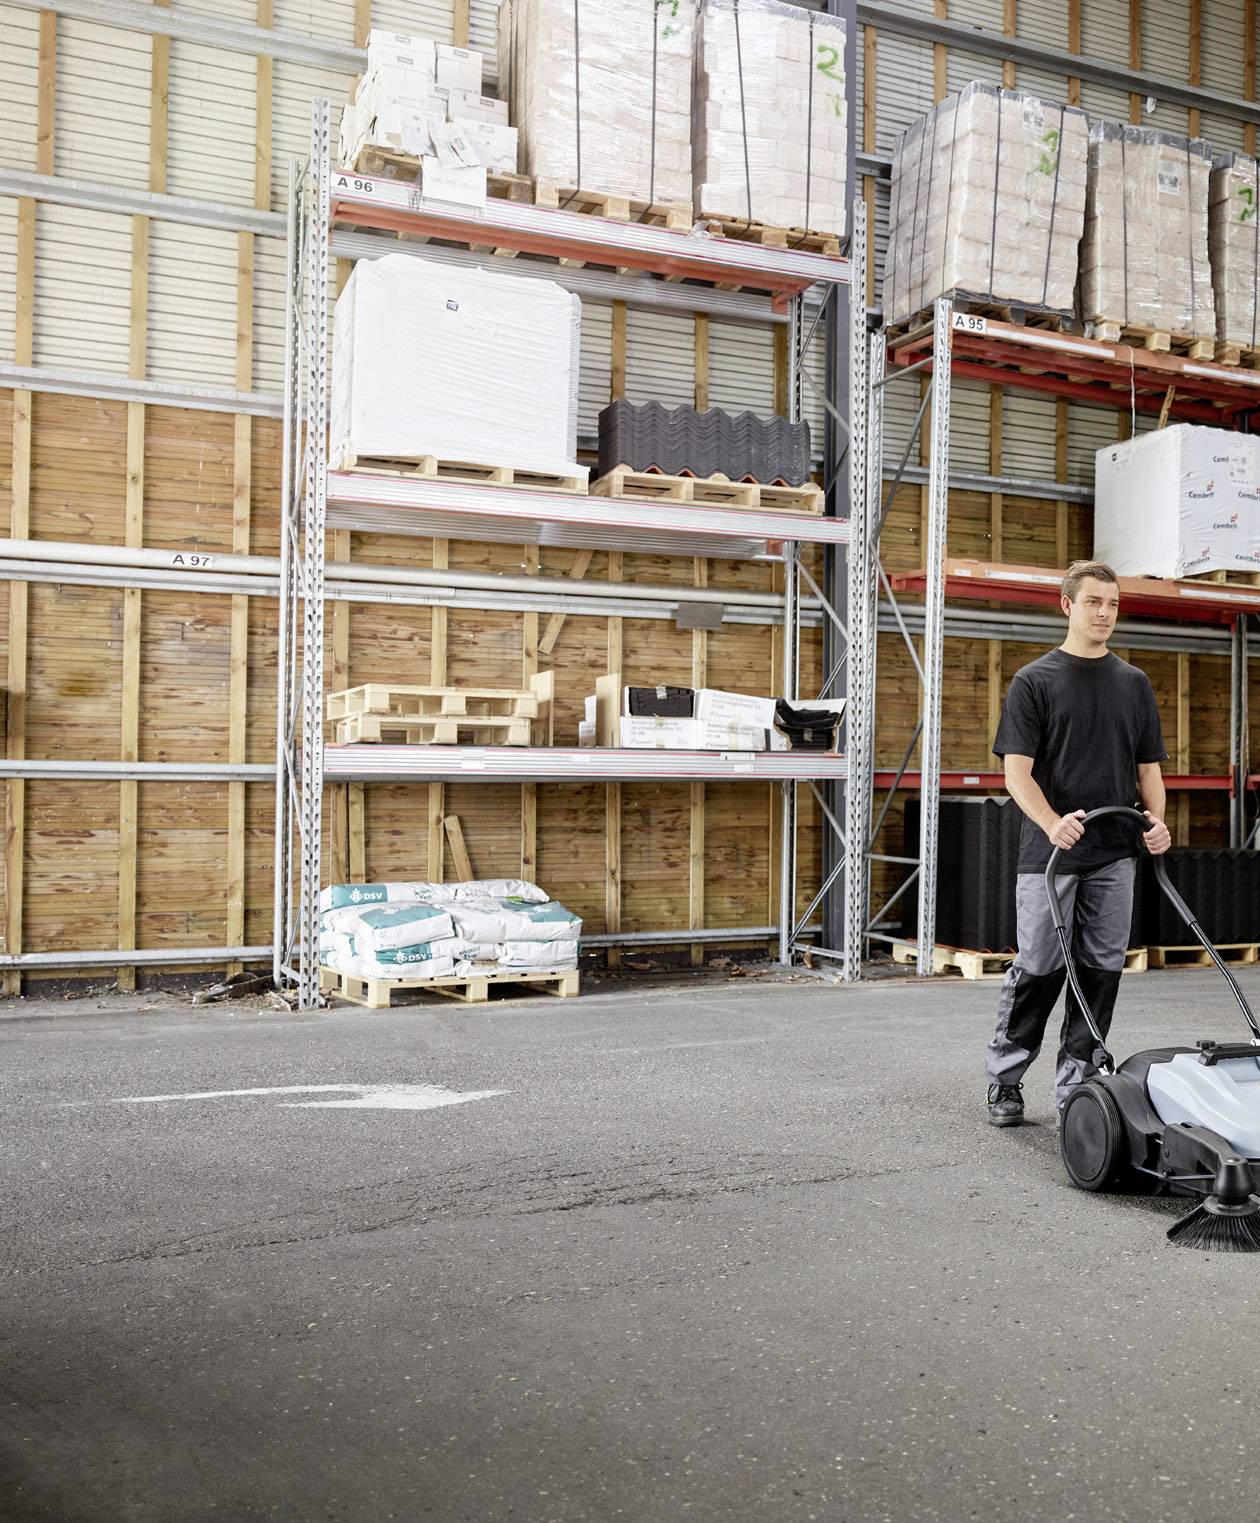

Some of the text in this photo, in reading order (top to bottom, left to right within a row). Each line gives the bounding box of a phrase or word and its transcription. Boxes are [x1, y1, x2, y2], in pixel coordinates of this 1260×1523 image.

[816, 44, 845, 84] 2
[338, 177, 373, 193] A 96
[956, 315, 983, 331] A 95
[1188, 490, 1215, 499] Cembrit
[1213, 522, 1238, 530] Cembrit
[172, 554, 211, 566] A 97
[1183, 556, 1210, 569] Cembrit
[364, 892, 382, 900] DSV
[409, 953, 427, 961] DSV
